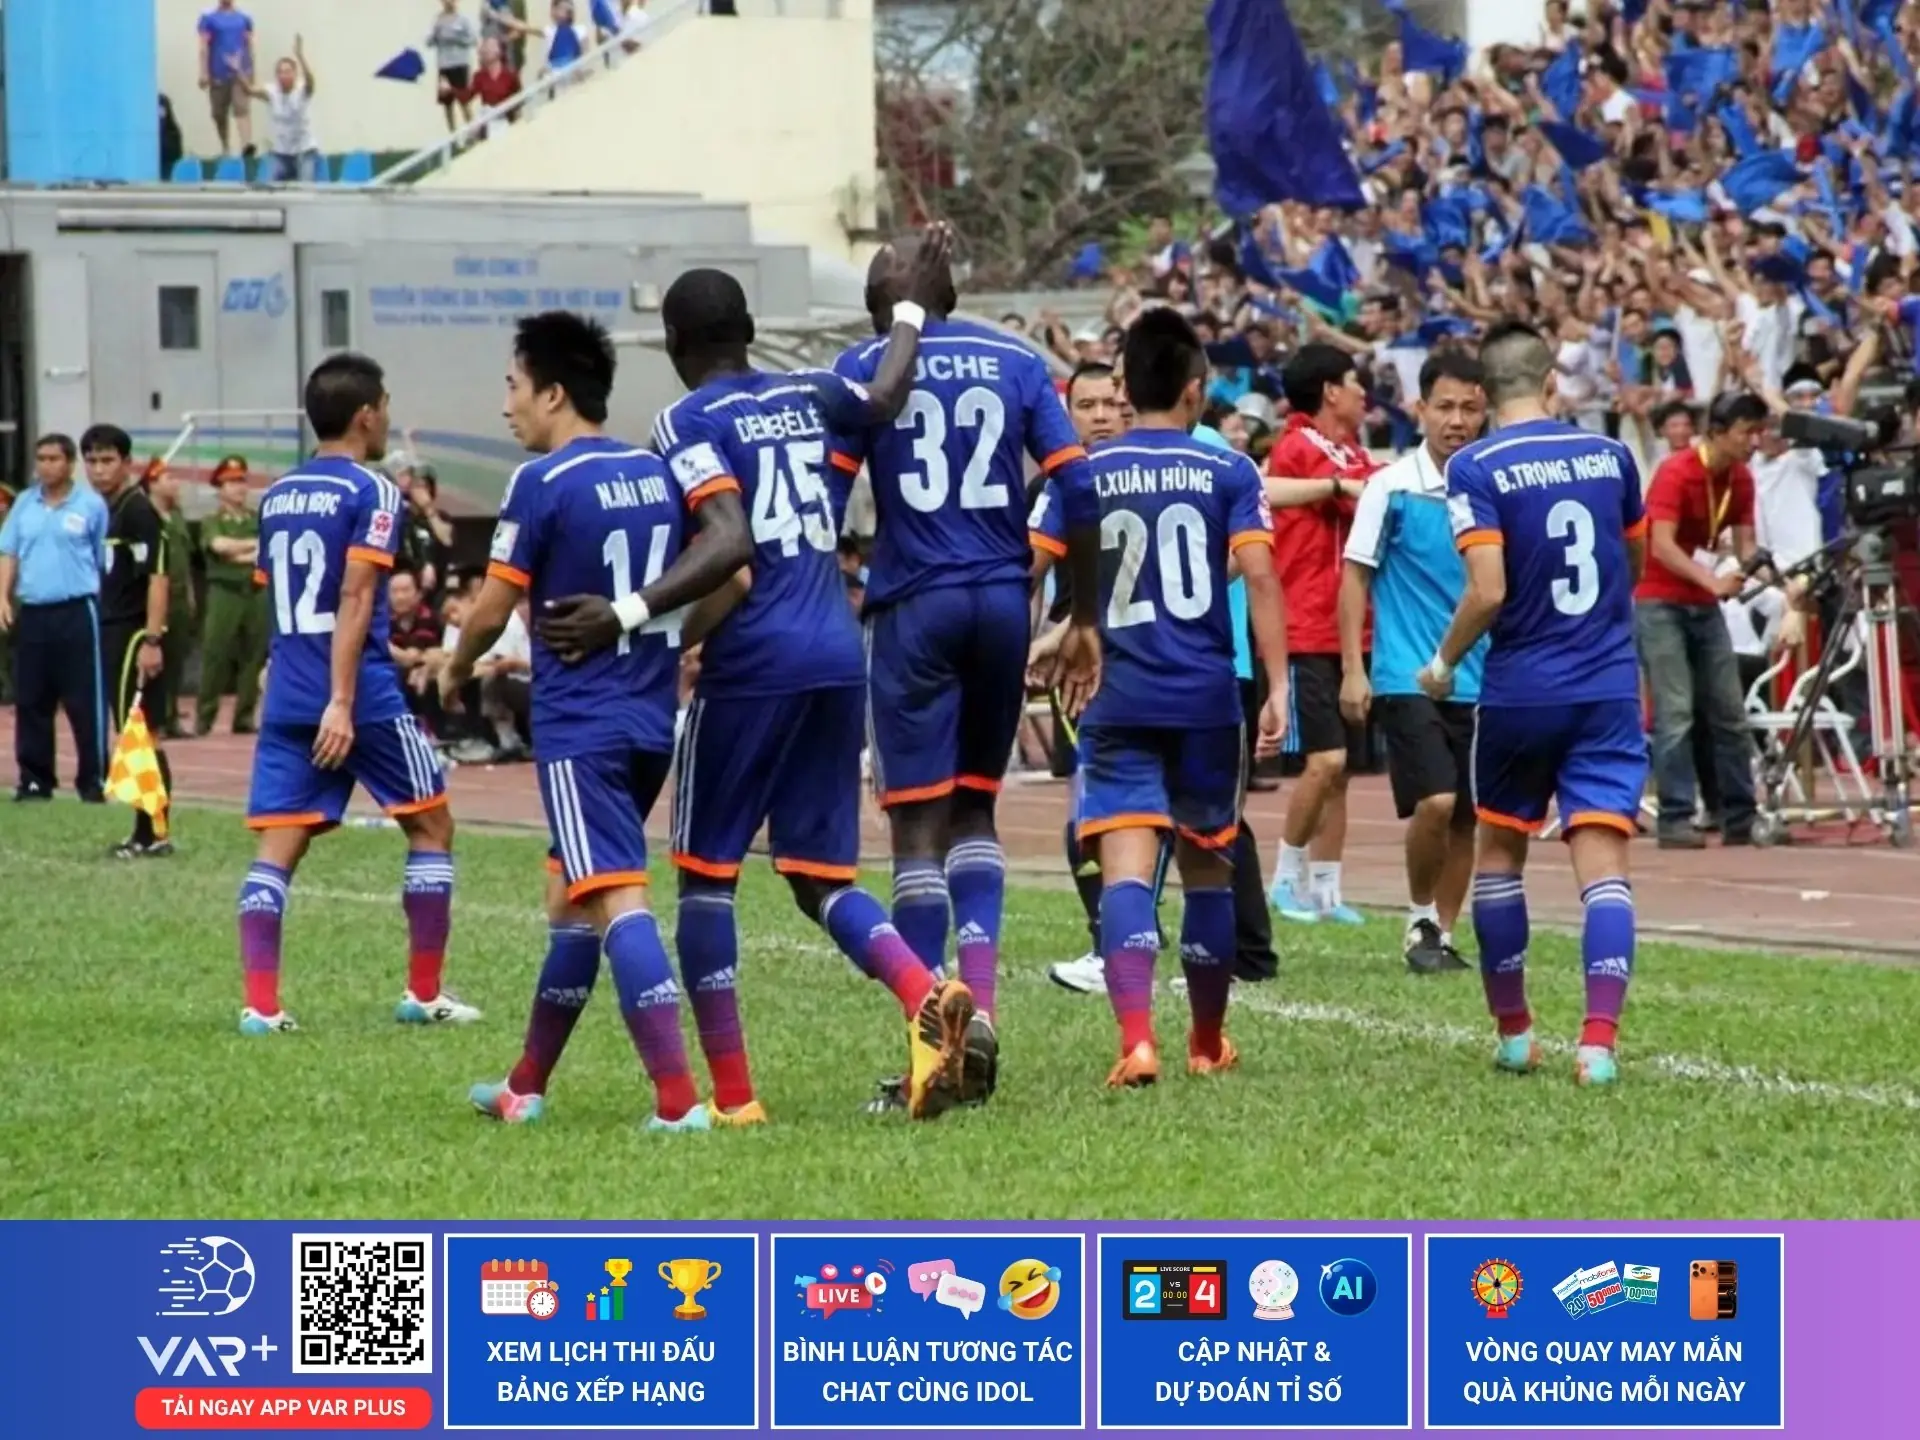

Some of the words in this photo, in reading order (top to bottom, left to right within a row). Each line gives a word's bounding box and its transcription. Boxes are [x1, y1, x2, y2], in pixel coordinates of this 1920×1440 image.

[752, 440, 837, 557] 45
[894, 386, 1010, 512] 32
[1161, 460, 1213, 494] HÙNG
[1493, 459, 1571, 494] B.TRỌNG
[268, 530, 336, 635] 12
[603, 523, 692, 656] 14
[1100, 502, 1213, 628] 20
[1546, 500, 1600, 616] 3
